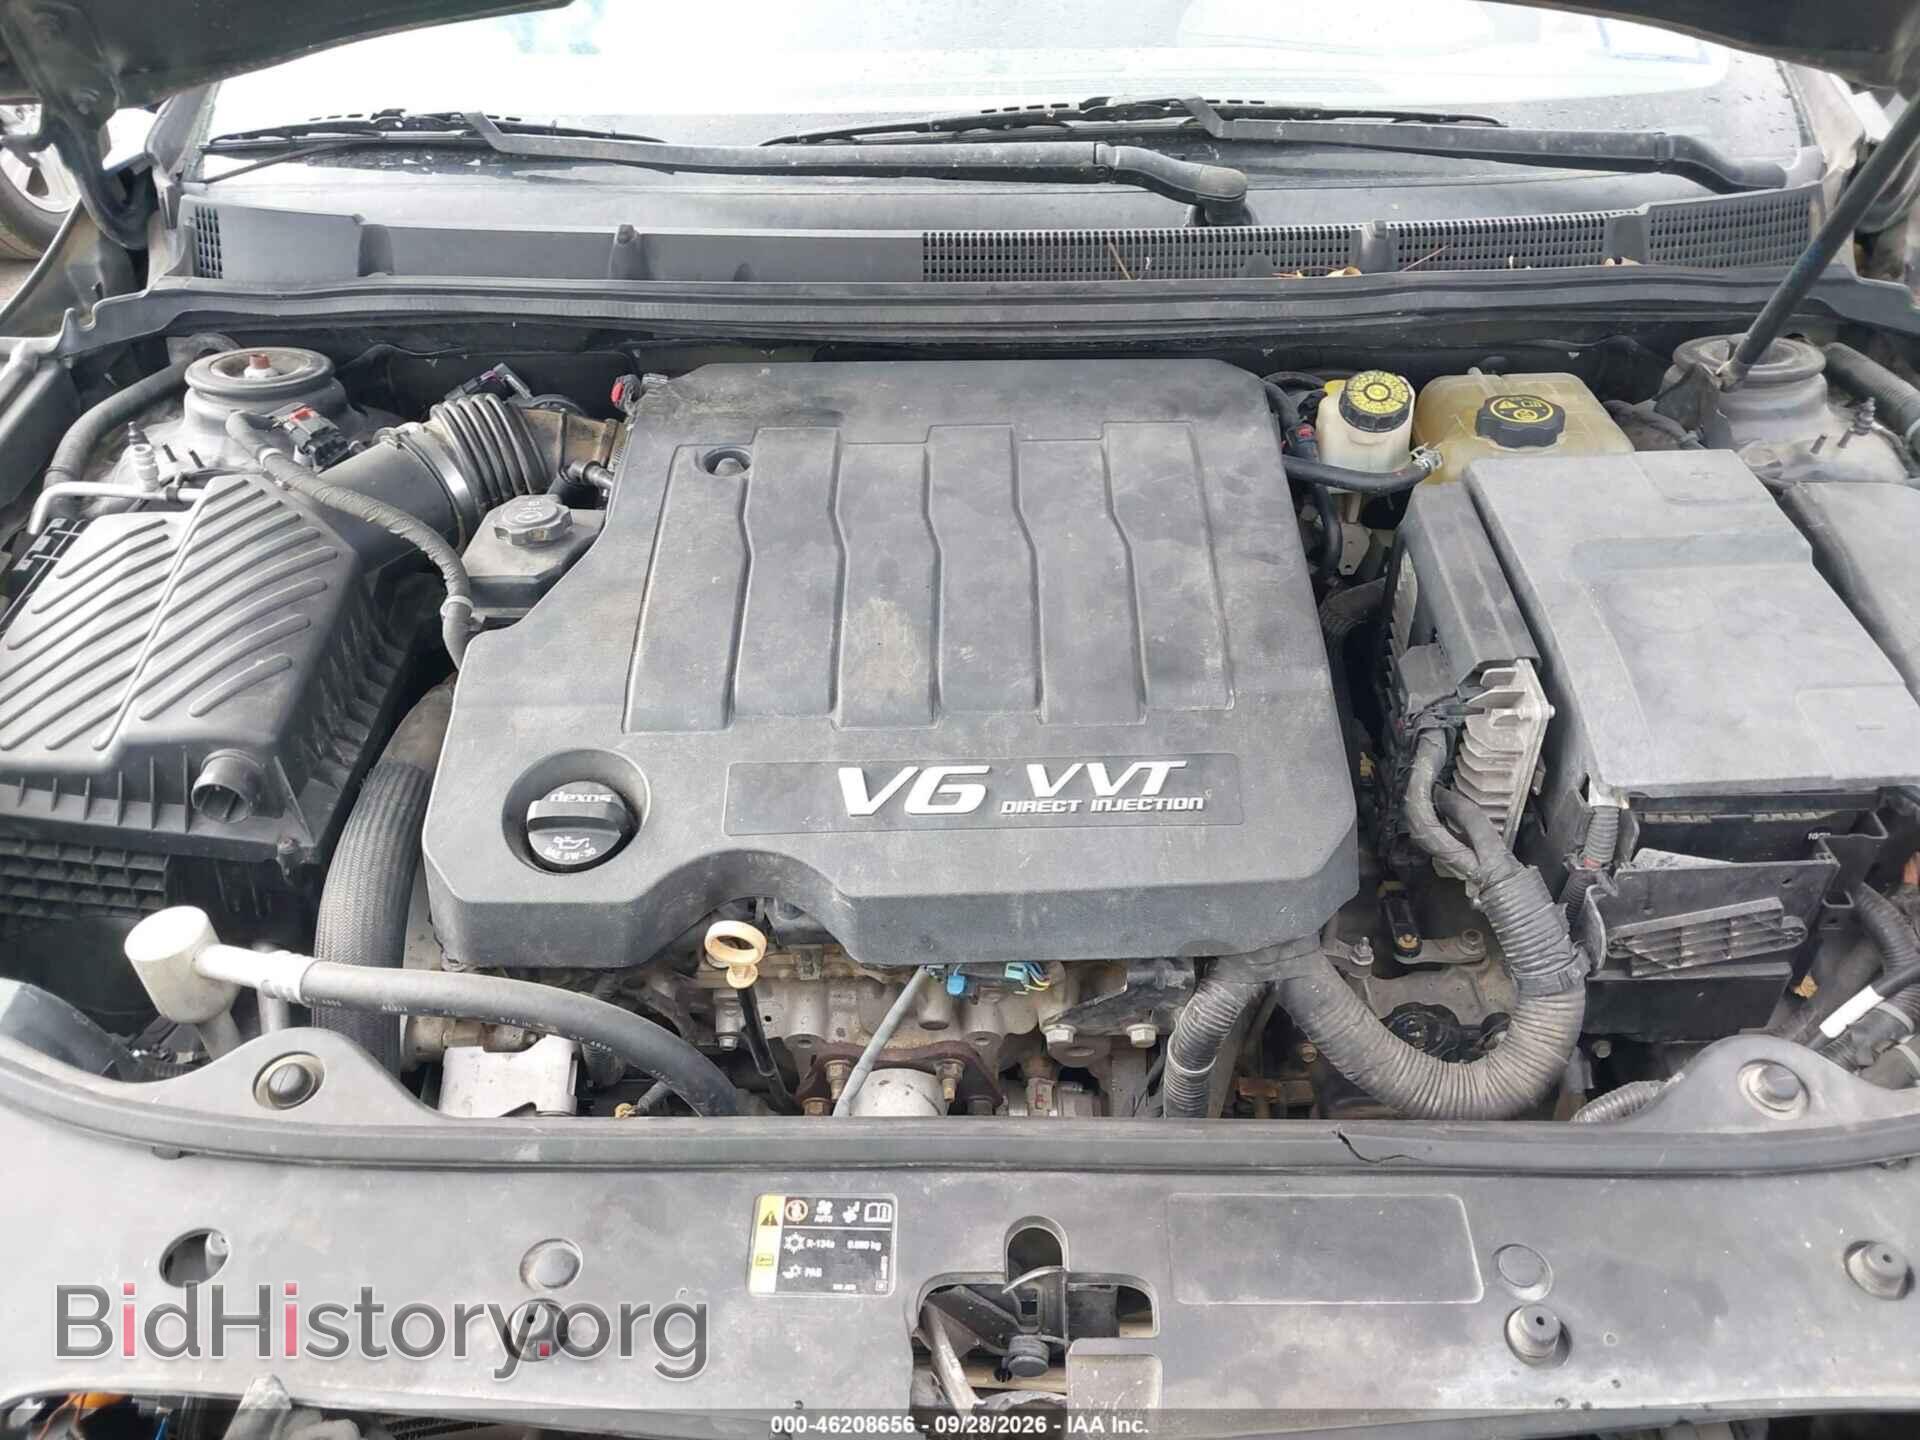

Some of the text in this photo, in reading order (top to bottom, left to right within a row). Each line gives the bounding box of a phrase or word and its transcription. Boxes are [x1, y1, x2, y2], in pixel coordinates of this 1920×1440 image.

[838, 760, 1188, 817] V6 VVT
[1000, 797, 1205, 816] DIRECT INJECTION
